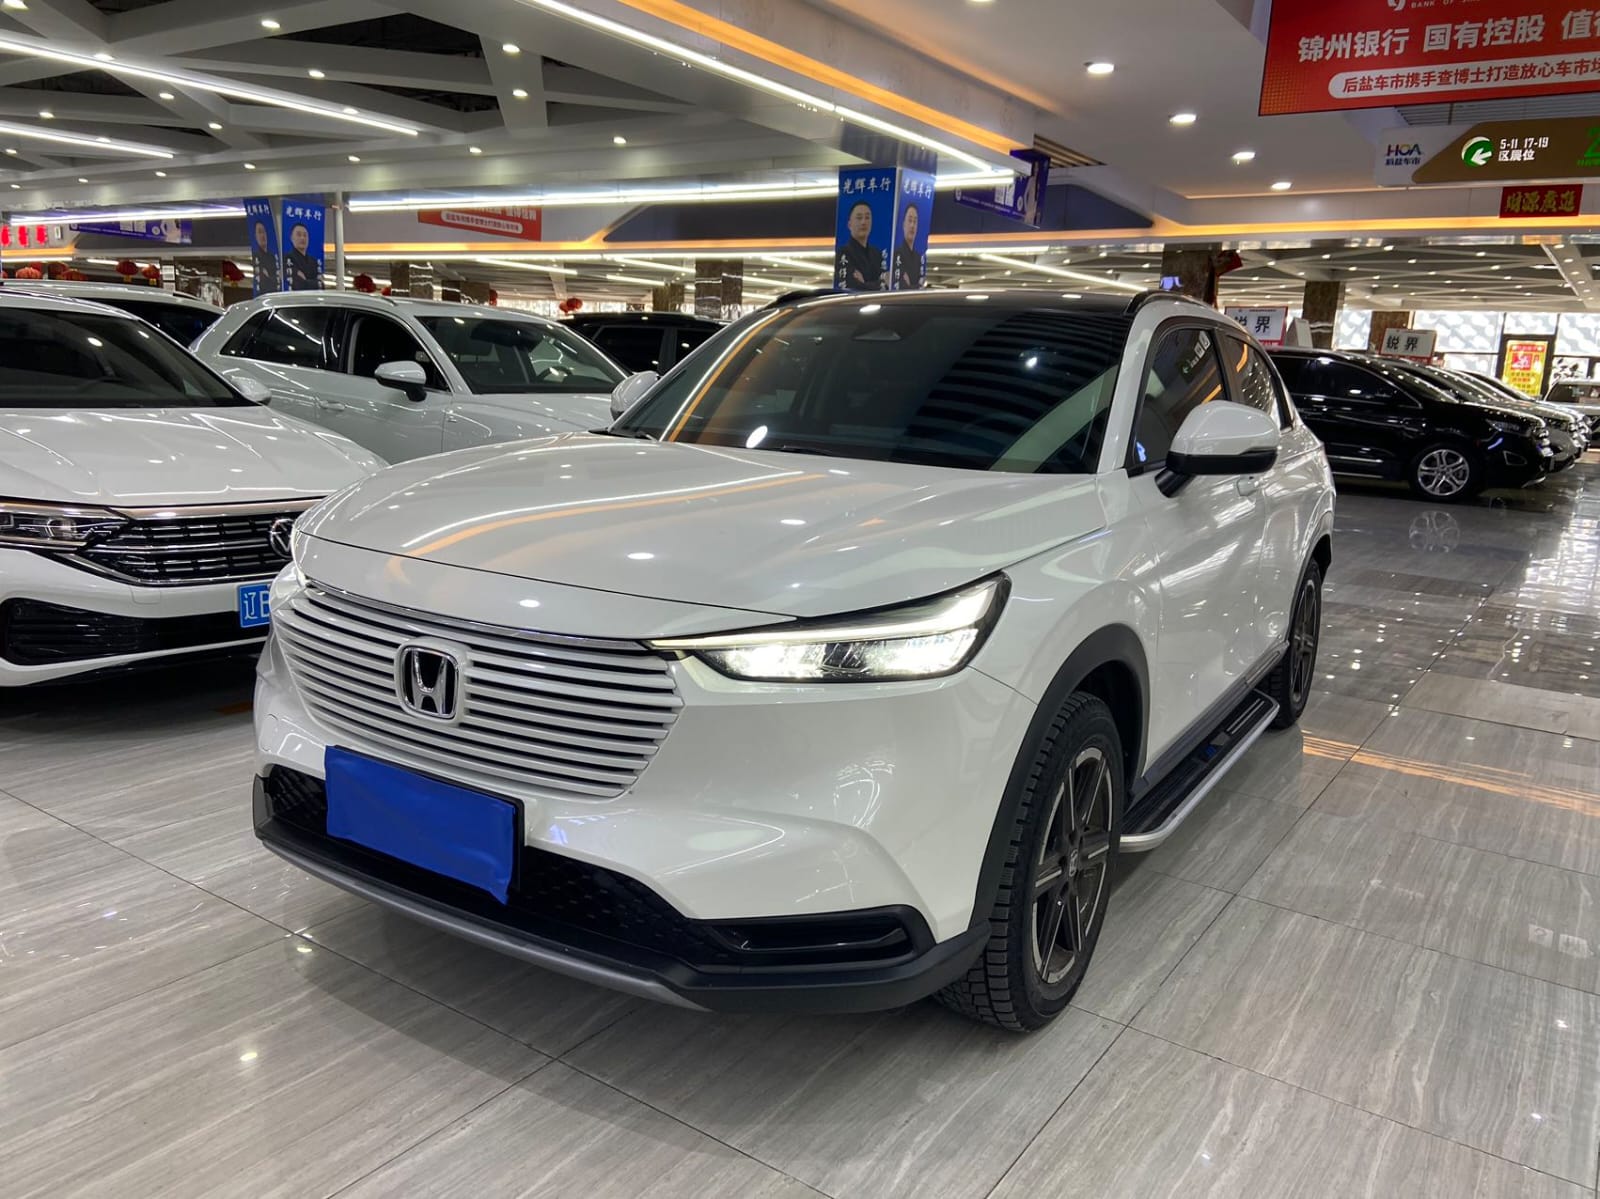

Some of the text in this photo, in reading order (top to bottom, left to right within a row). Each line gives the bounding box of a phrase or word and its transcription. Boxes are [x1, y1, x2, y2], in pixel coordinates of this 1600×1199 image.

[1411, 1, 1435, 9] BANK
[1298, 28, 1410, 62] 锦州银行
[1423, 14, 1546, 52] 国有控股
[1387, 143, 1422, 156] HOA
[1500, 136, 1549, 150] 5-11 17-19
[1498, 149, 1536, 162] 区展位
